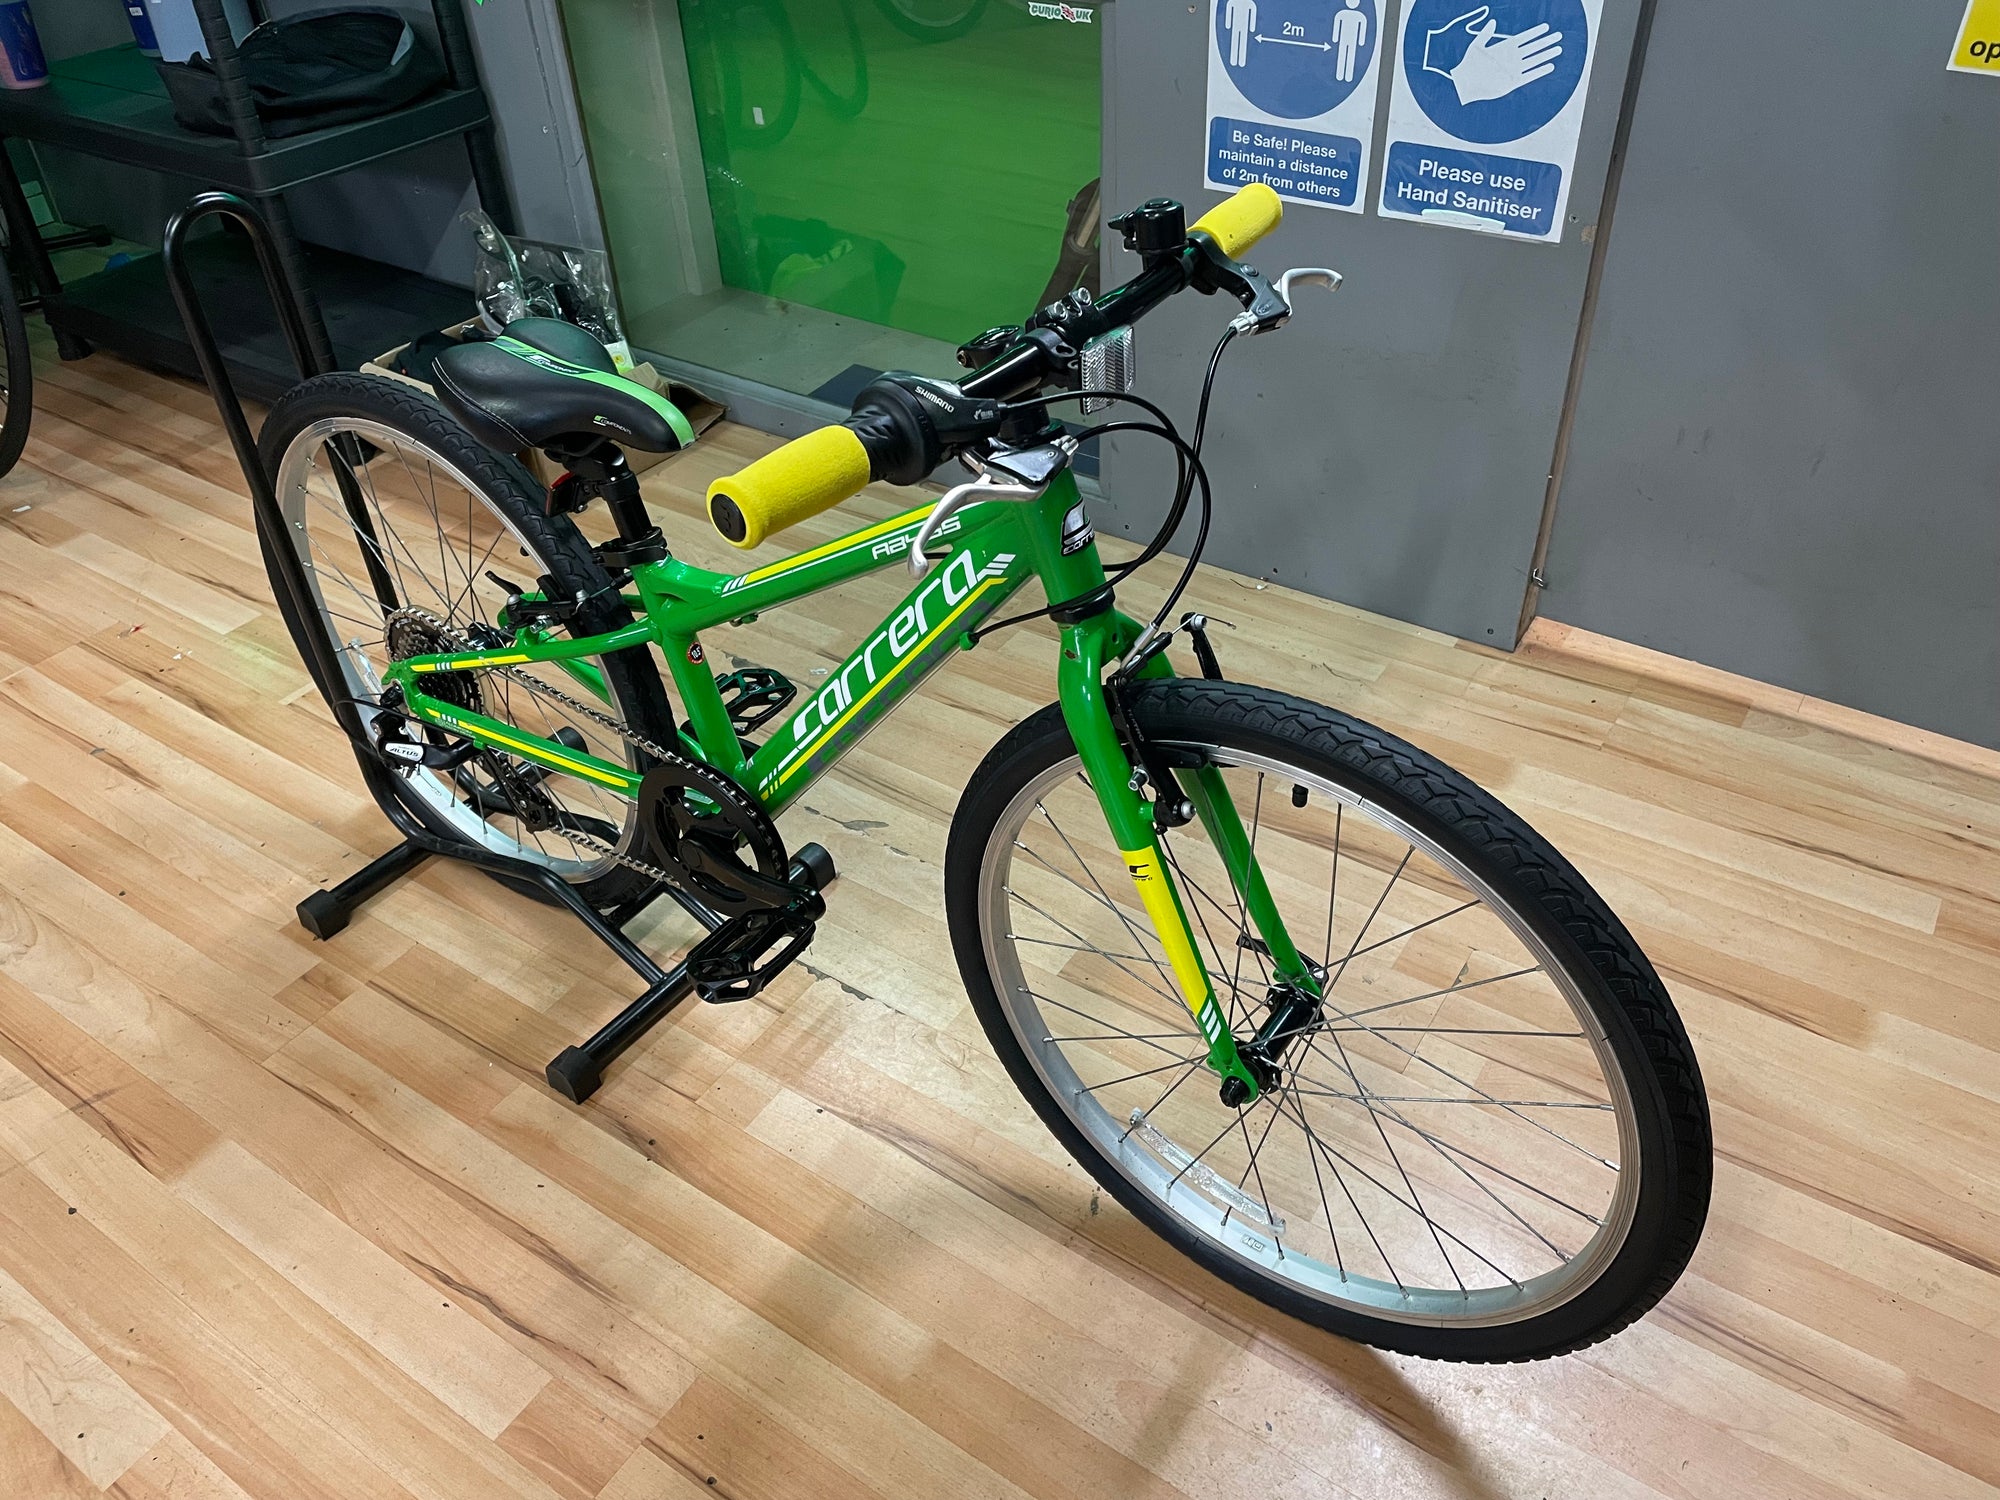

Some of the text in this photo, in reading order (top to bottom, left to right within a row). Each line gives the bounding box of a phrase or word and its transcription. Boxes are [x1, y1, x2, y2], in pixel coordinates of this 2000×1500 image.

[1031, 4, 1090, 21] CURIO UK
[1282, 21, 1305, 37] 2m
[1232, 129, 1337, 159] Be Safe! Please
[1218, 149, 1348, 180] maintain a distance
[1418, 159, 1526, 191] Please use
[1223, 167, 1341, 198] of 2m from others
[1397, 181, 1541, 220] Hand Sanitiser
[914, 385, 955, 413] SHIMANO
[793, 549, 979, 751] carrera
[390, 747, 419, 757] ALTUS
